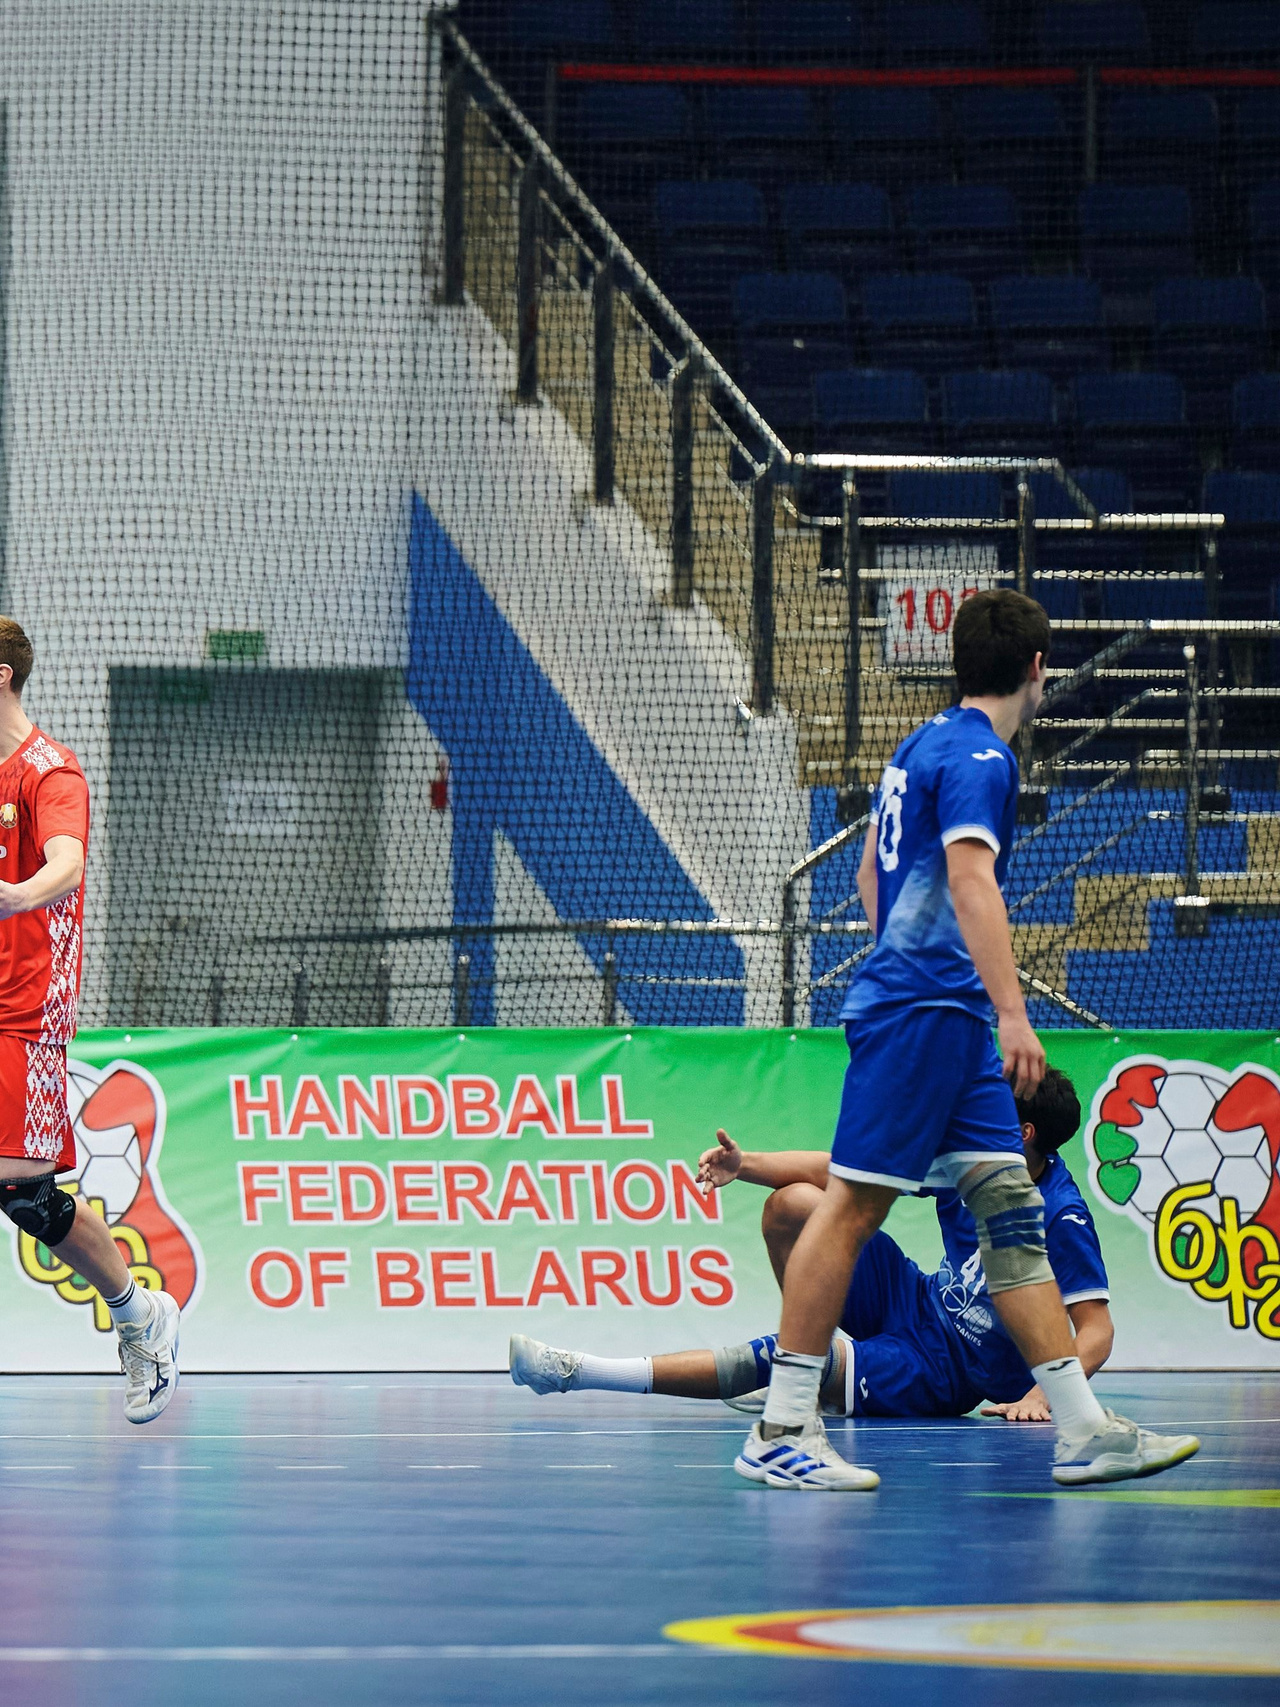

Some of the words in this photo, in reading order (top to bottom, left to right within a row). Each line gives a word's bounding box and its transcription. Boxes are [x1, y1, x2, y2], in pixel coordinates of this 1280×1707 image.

[896, 587, 979, 634] 10
[234, 1078, 651, 1138] HANDBALL
[242, 1163, 720, 1223] FEDERATION
[249, 1250, 348, 1310] OF
[376, 1249, 735, 1310] BELARUS
